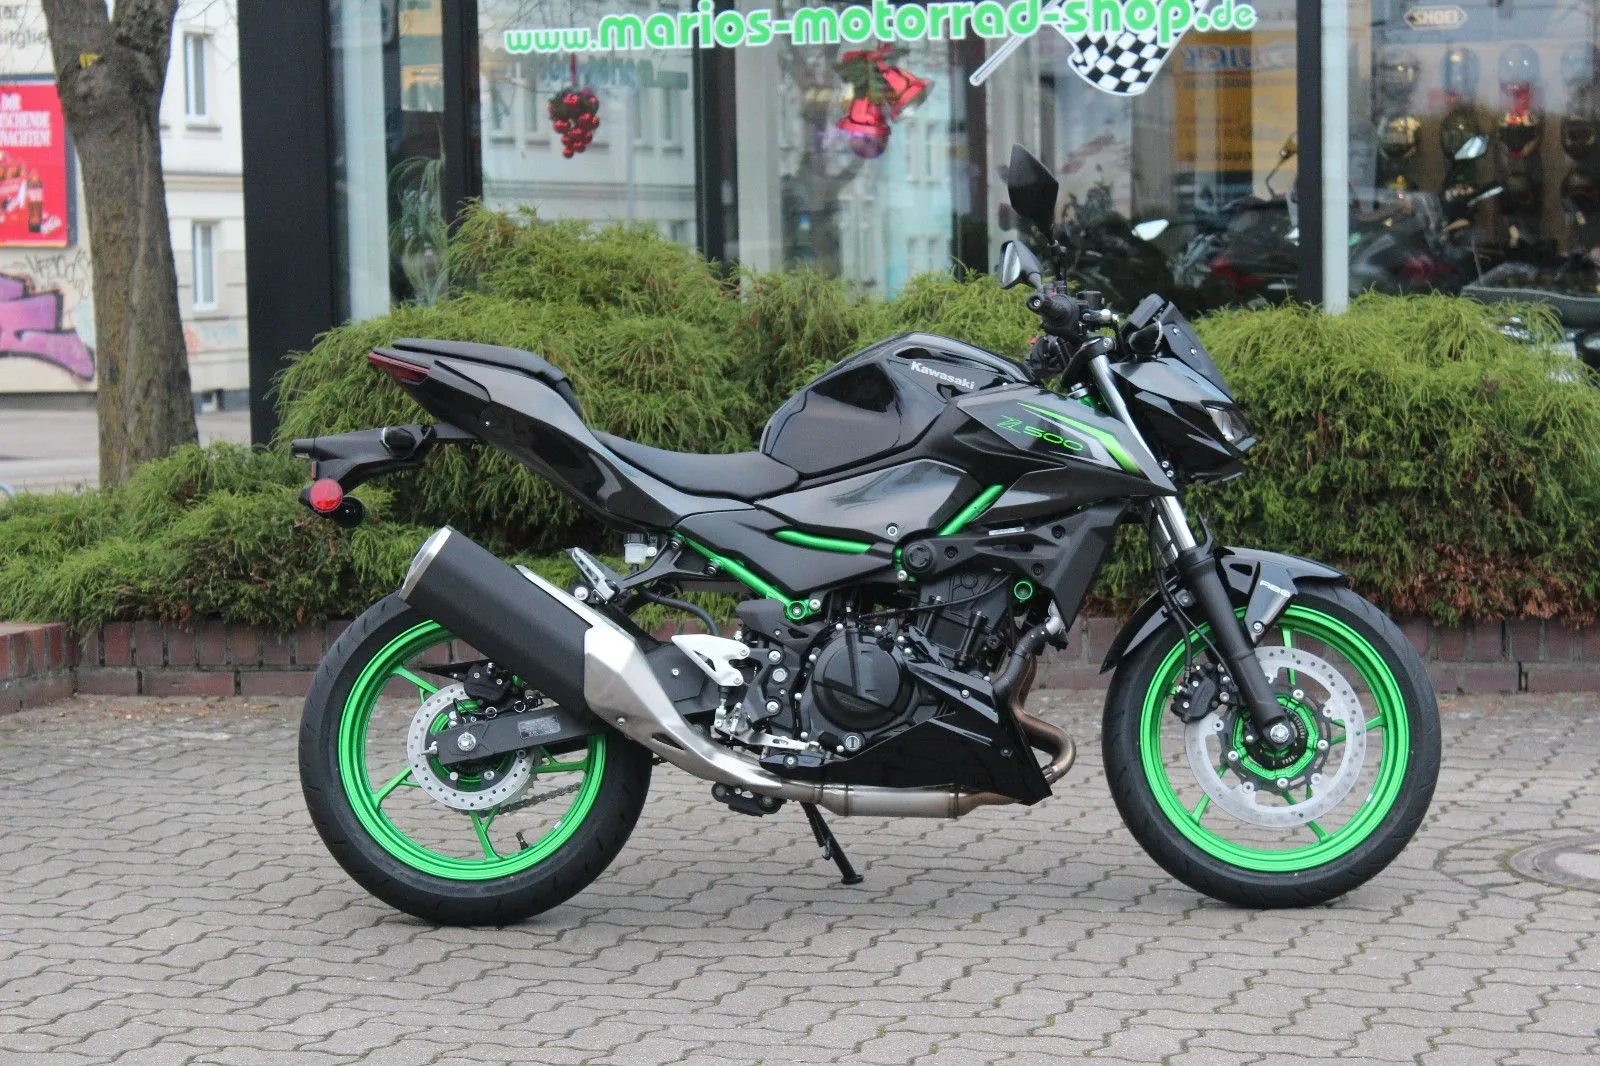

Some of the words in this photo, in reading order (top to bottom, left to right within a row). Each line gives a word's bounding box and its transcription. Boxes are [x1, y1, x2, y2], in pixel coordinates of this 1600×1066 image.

[504, 0, 1257, 54] www.marios-motorrad-shop.de
[911, 361, 975, 390] Kawasaki
[1260, 580, 1290, 598] ABS
